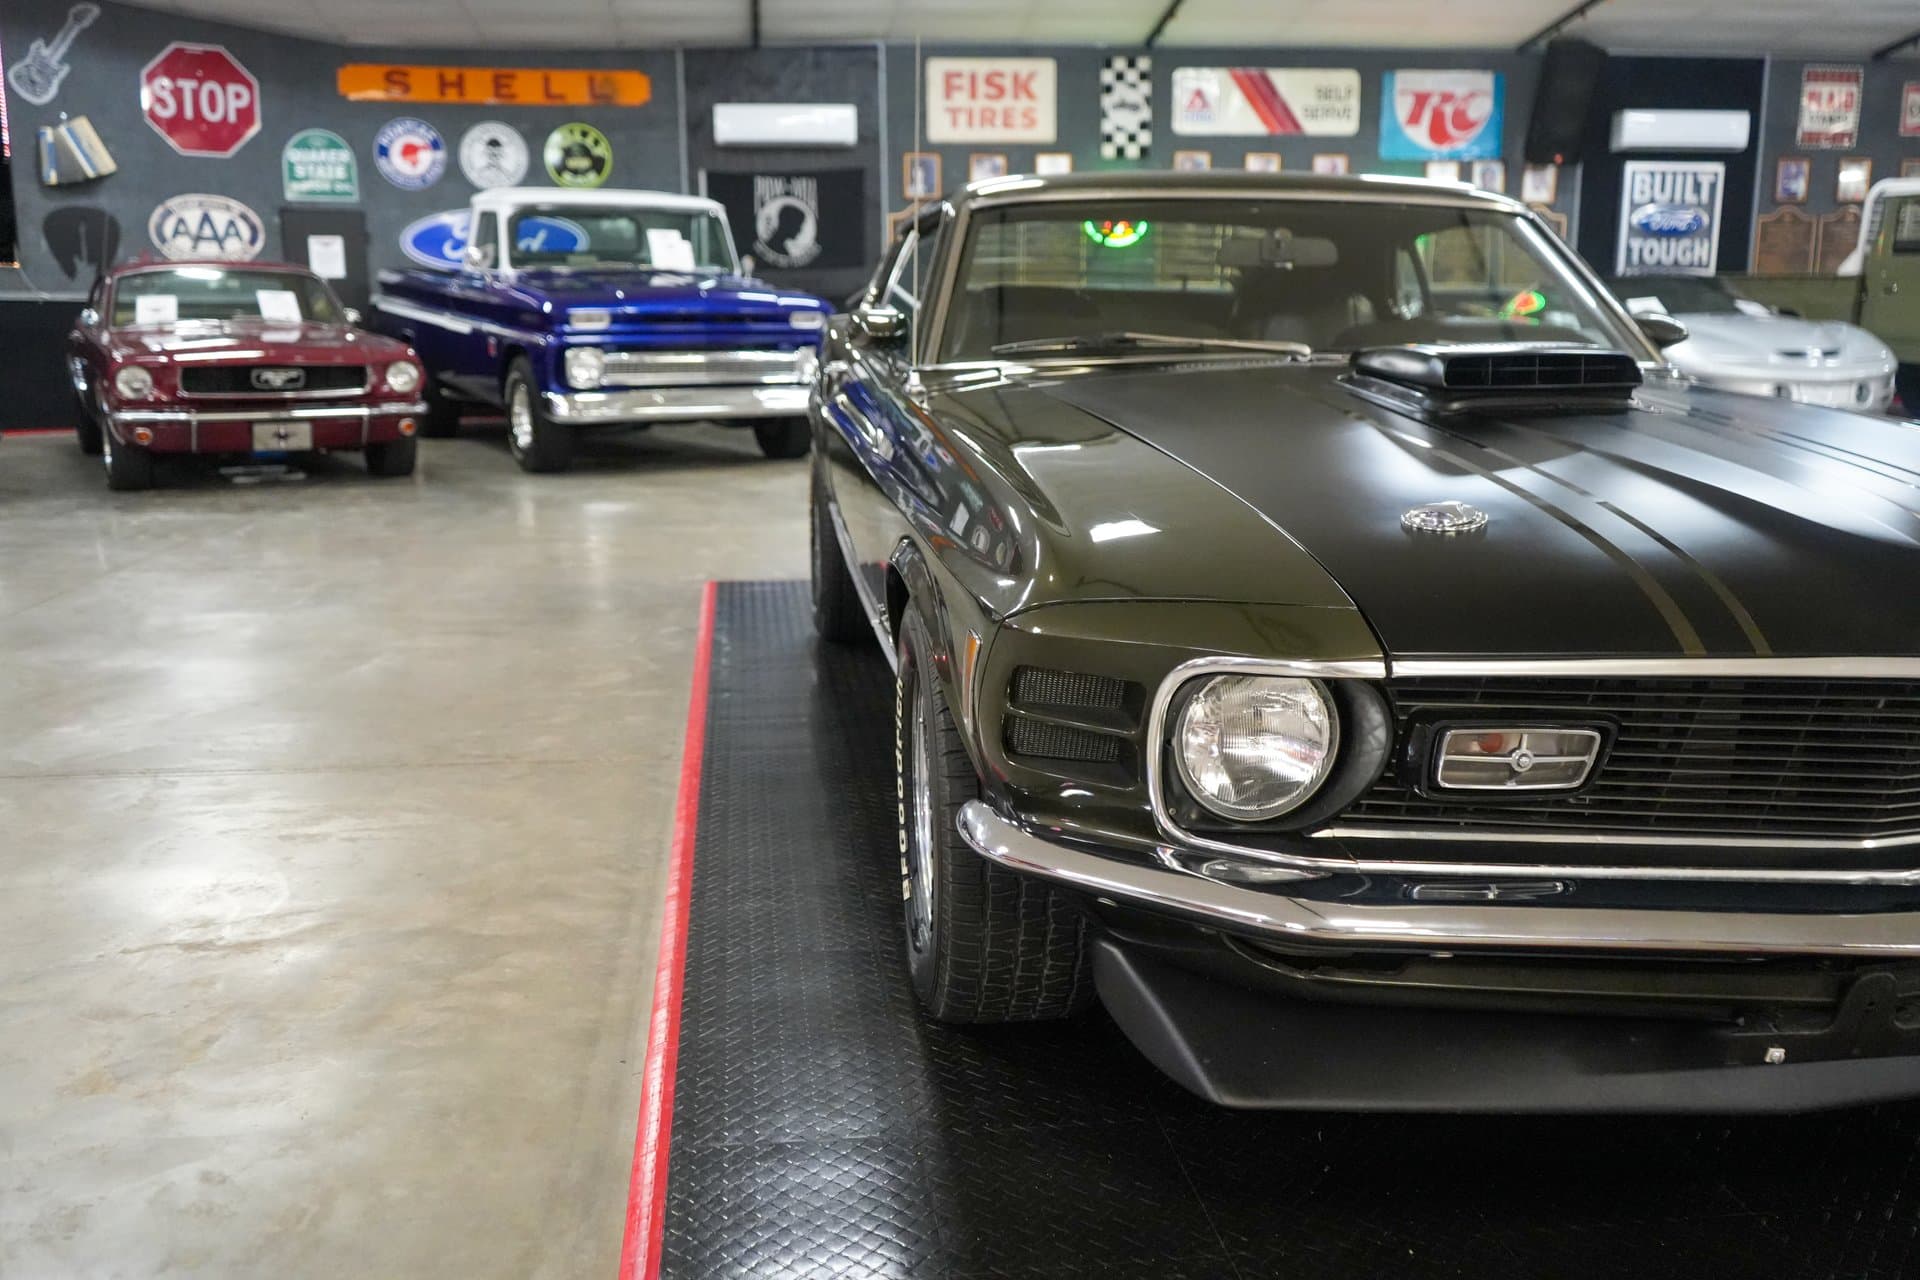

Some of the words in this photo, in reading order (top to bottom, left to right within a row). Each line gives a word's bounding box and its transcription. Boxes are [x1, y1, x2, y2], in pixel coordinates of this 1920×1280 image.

[151, 75, 252, 124] STOP
[383, 69, 614, 102] SHELL
[943, 70, 1037, 101] FISK
[1316, 85, 1353, 101] SELF
[945, 106, 1038, 129] TIRES
[1302, 106, 1353, 121] SERVE
[1403, 90, 1484, 146] RC
[1632, 172, 1717, 204] BUILT
[172, 210, 243, 252] AAA
[1628, 238, 1711, 266] TOUGH
[895, 677, 912, 901] BFGoodrich
